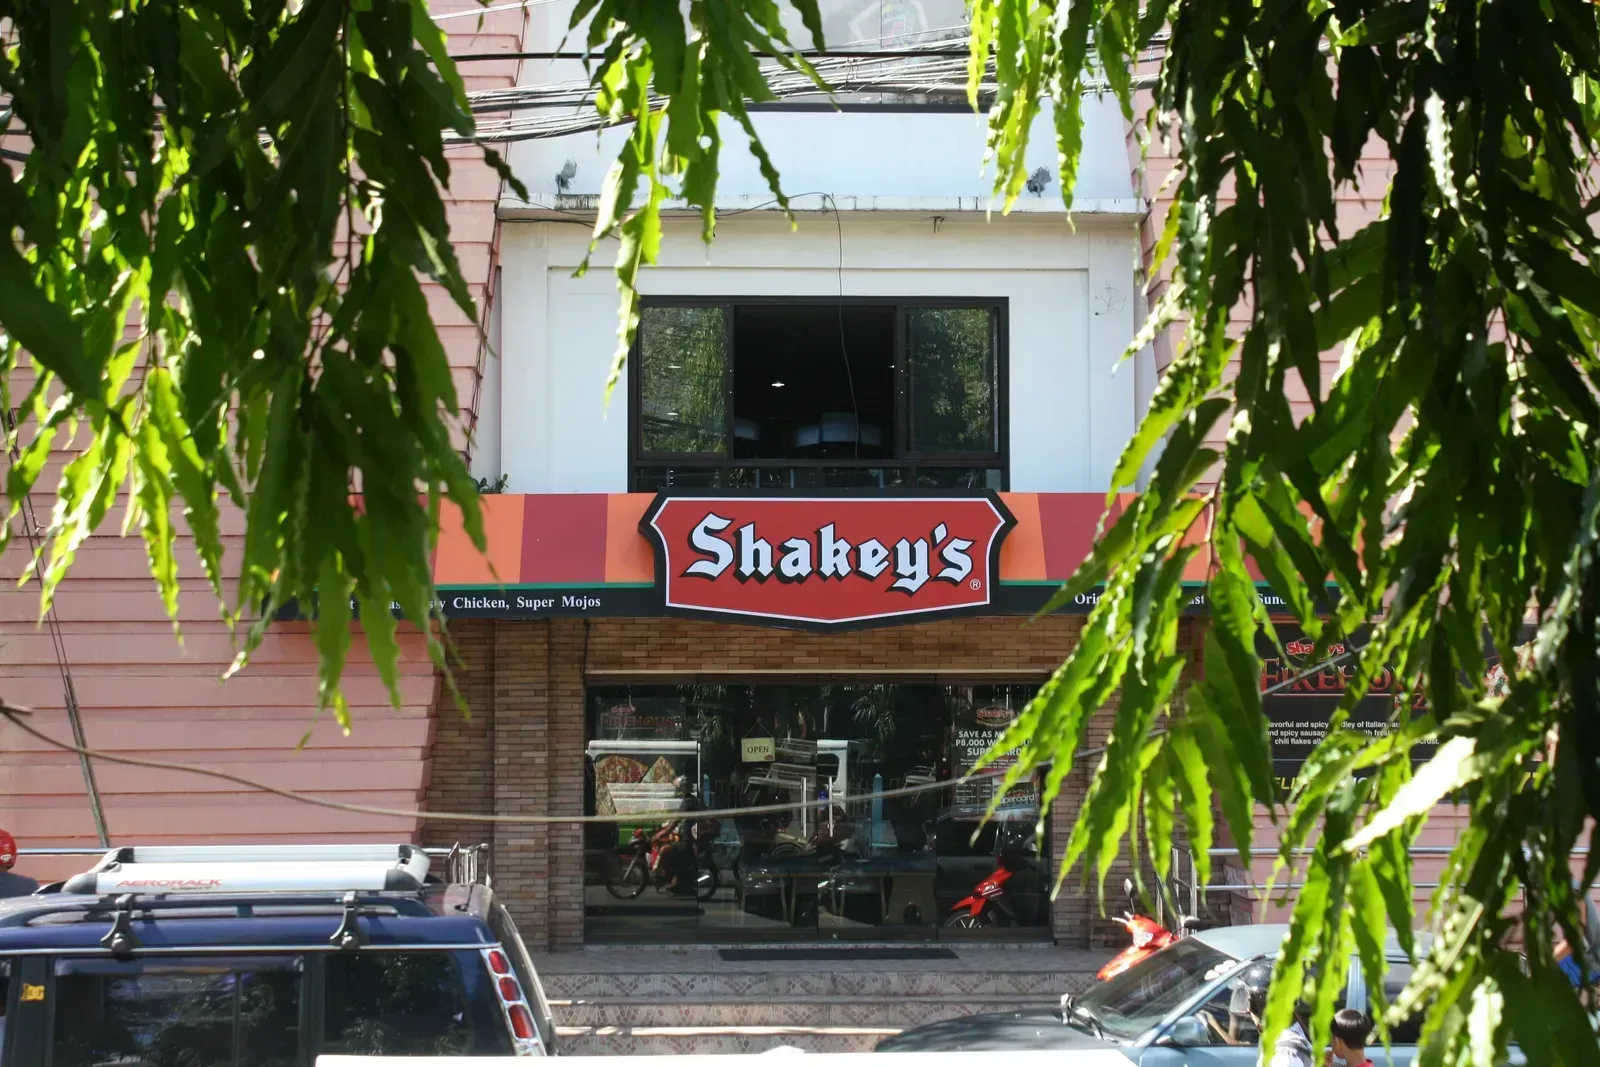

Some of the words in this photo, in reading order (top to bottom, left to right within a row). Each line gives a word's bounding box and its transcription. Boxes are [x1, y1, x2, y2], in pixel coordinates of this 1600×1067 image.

[680, 512, 976, 596] Shakey's
[453, 597, 510, 610] Chicken,
[517, 596, 555, 611] Super
[561, 595, 601, 610] Mojos
[1286, 640, 1345, 656] Shay's
[1267, 720, 1294, 728] lavorful
[1310, 720, 1329, 729] spicy
[1341, 721, 1355, 730] dley
[958, 730, 980, 738] SAVE
[981, 730, 993, 738] AS
[1280, 730, 1299, 738] spicy
[1300, 730, 1327, 739] sausag
[955, 739, 985, 747] P8,000
[747, 745, 769, 753] OPEN
[966, 747, 1022, 756] SUPEARD
[116, 879, 222, 888] AERORACK
